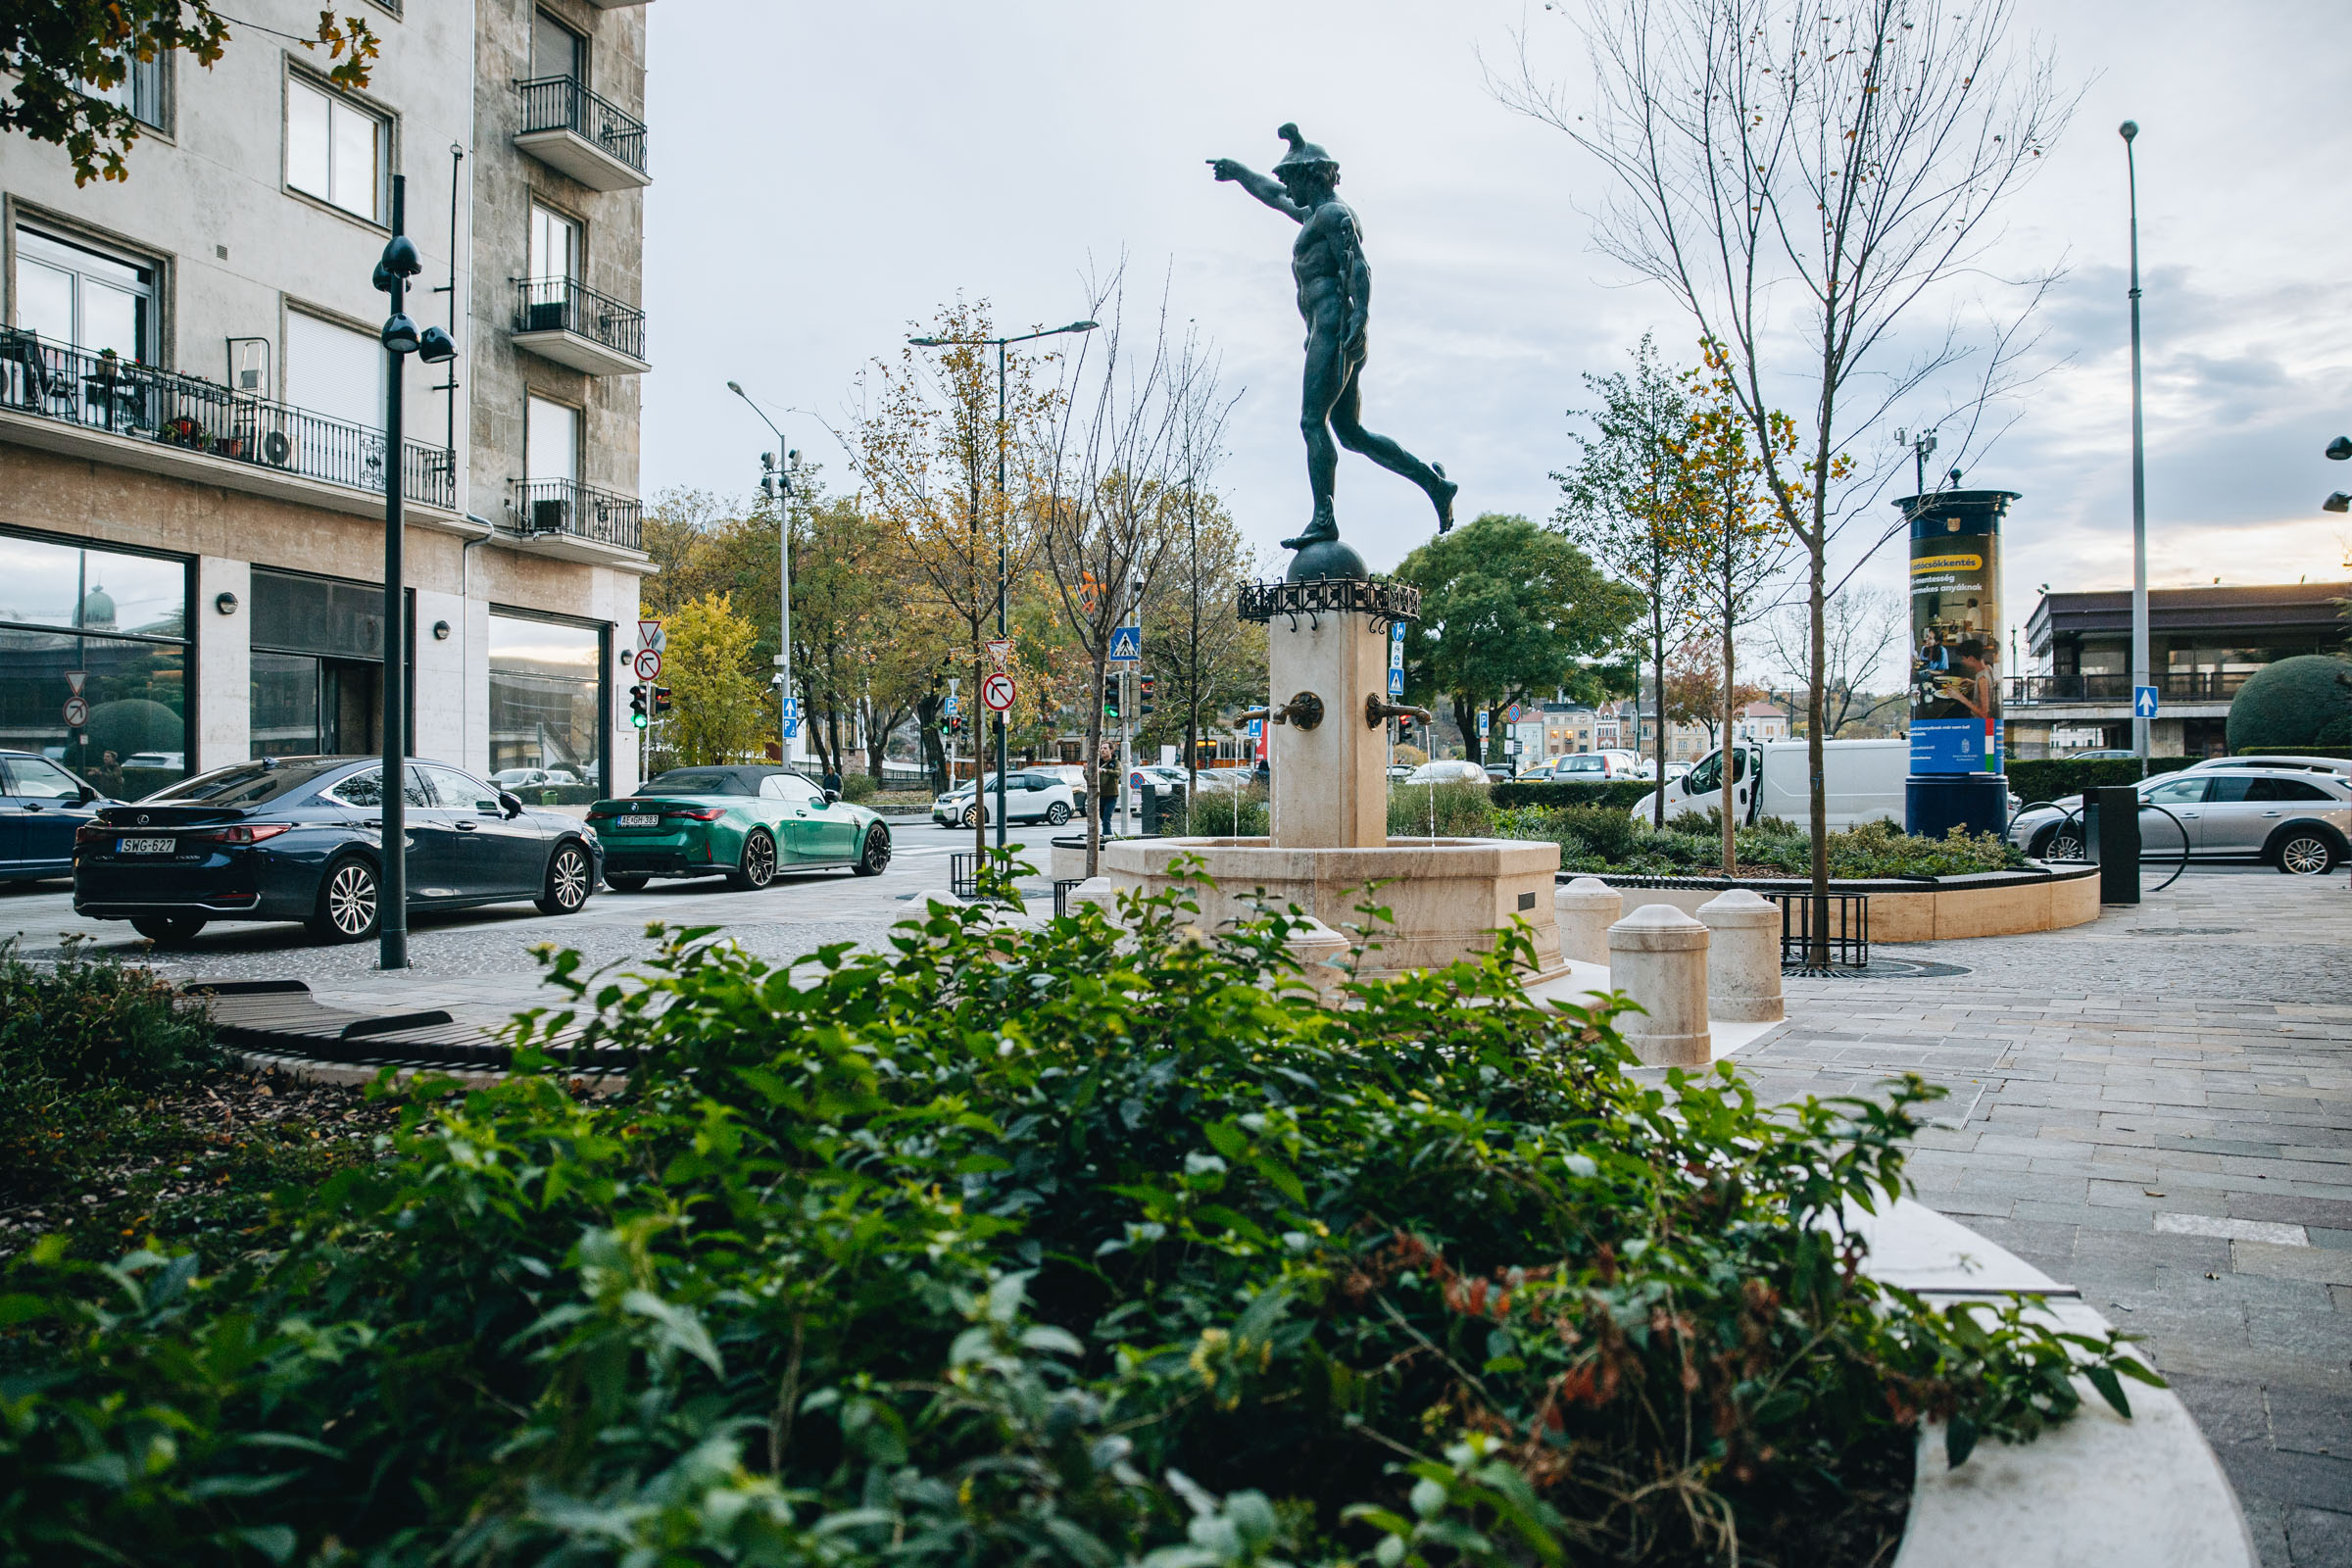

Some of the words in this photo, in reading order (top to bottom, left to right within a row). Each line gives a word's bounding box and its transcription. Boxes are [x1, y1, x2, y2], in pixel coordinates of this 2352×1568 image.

[1940, 583, 1983, 593] anyáknak
[784, 719, 791, 730] P
[123, 839, 173, 852] SWG-627
